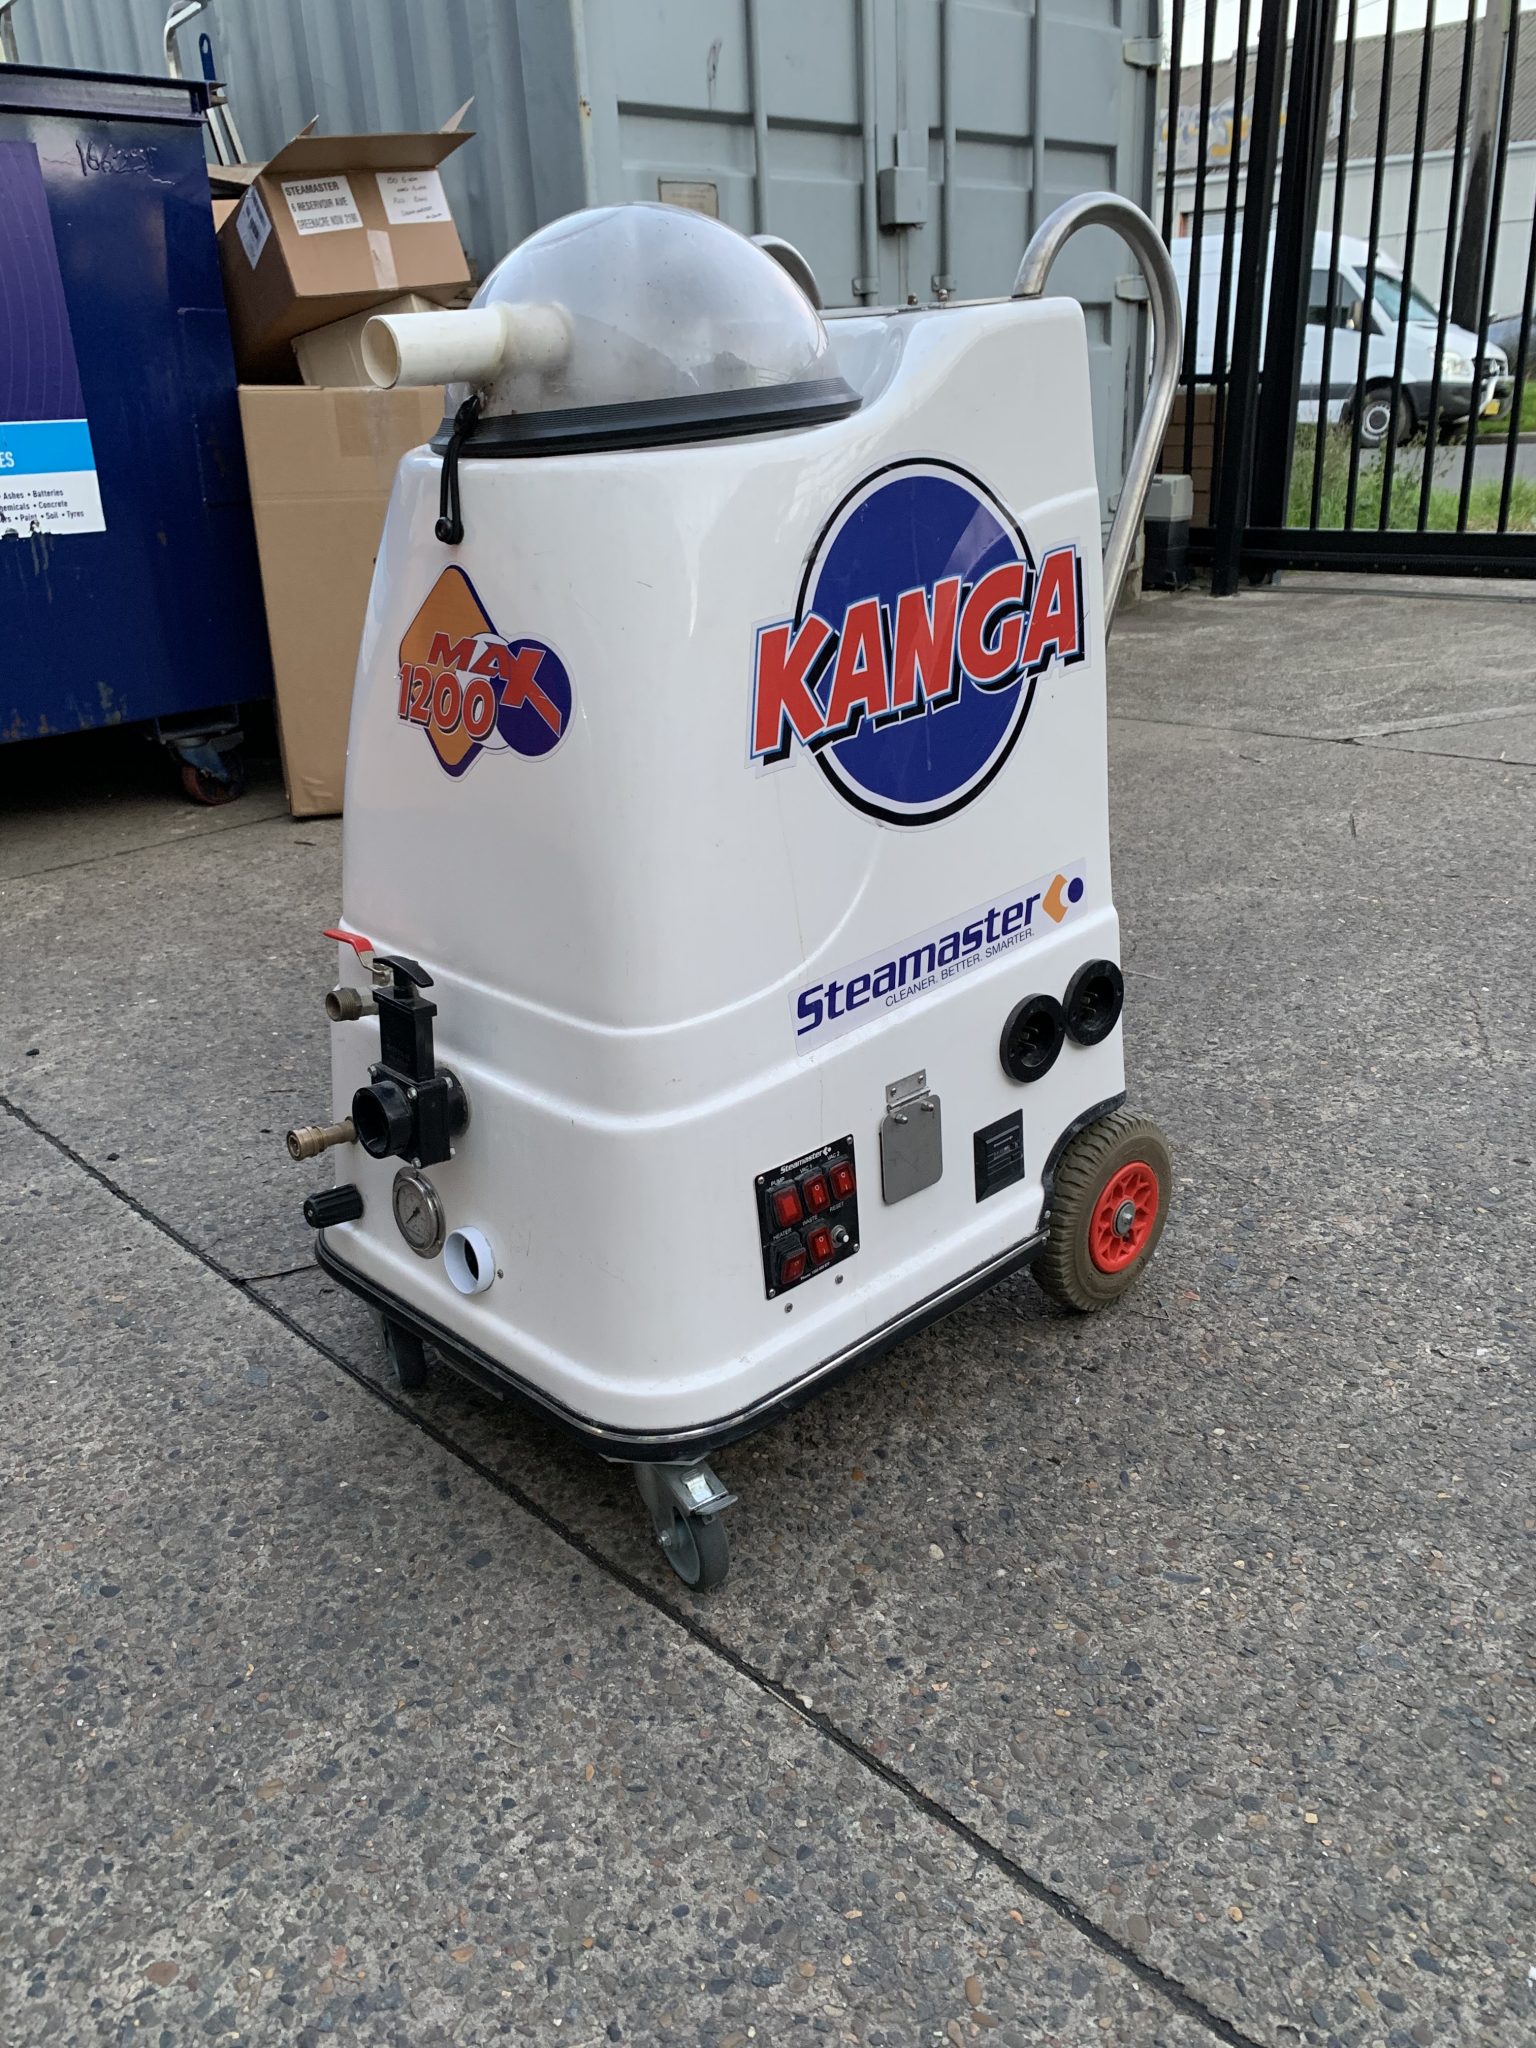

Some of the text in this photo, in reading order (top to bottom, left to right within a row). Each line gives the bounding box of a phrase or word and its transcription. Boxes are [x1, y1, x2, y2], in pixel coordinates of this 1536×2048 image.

[284, 181, 340, 196] STEAMASTER
[3, 489, 64, 500] Ashes Batteries
[38, 501, 68, 509] Concrete
[20, 513, 38, 521] Paint
[45, 512, 59, 520] Soil
[66, 510, 84, 519] Tyres
[750, 544, 1086, 767] KANGA
[425, 631, 562, 739] MAX
[397, 662, 496, 742] 1200
[797, 892, 1041, 1036] Steamaster
[885, 928, 1035, 1007] CLEANER. BETTER. SMARTER.
[780, 1149, 823, 1175] Steamaster
[773, 1227, 792, 1240] HEATER
